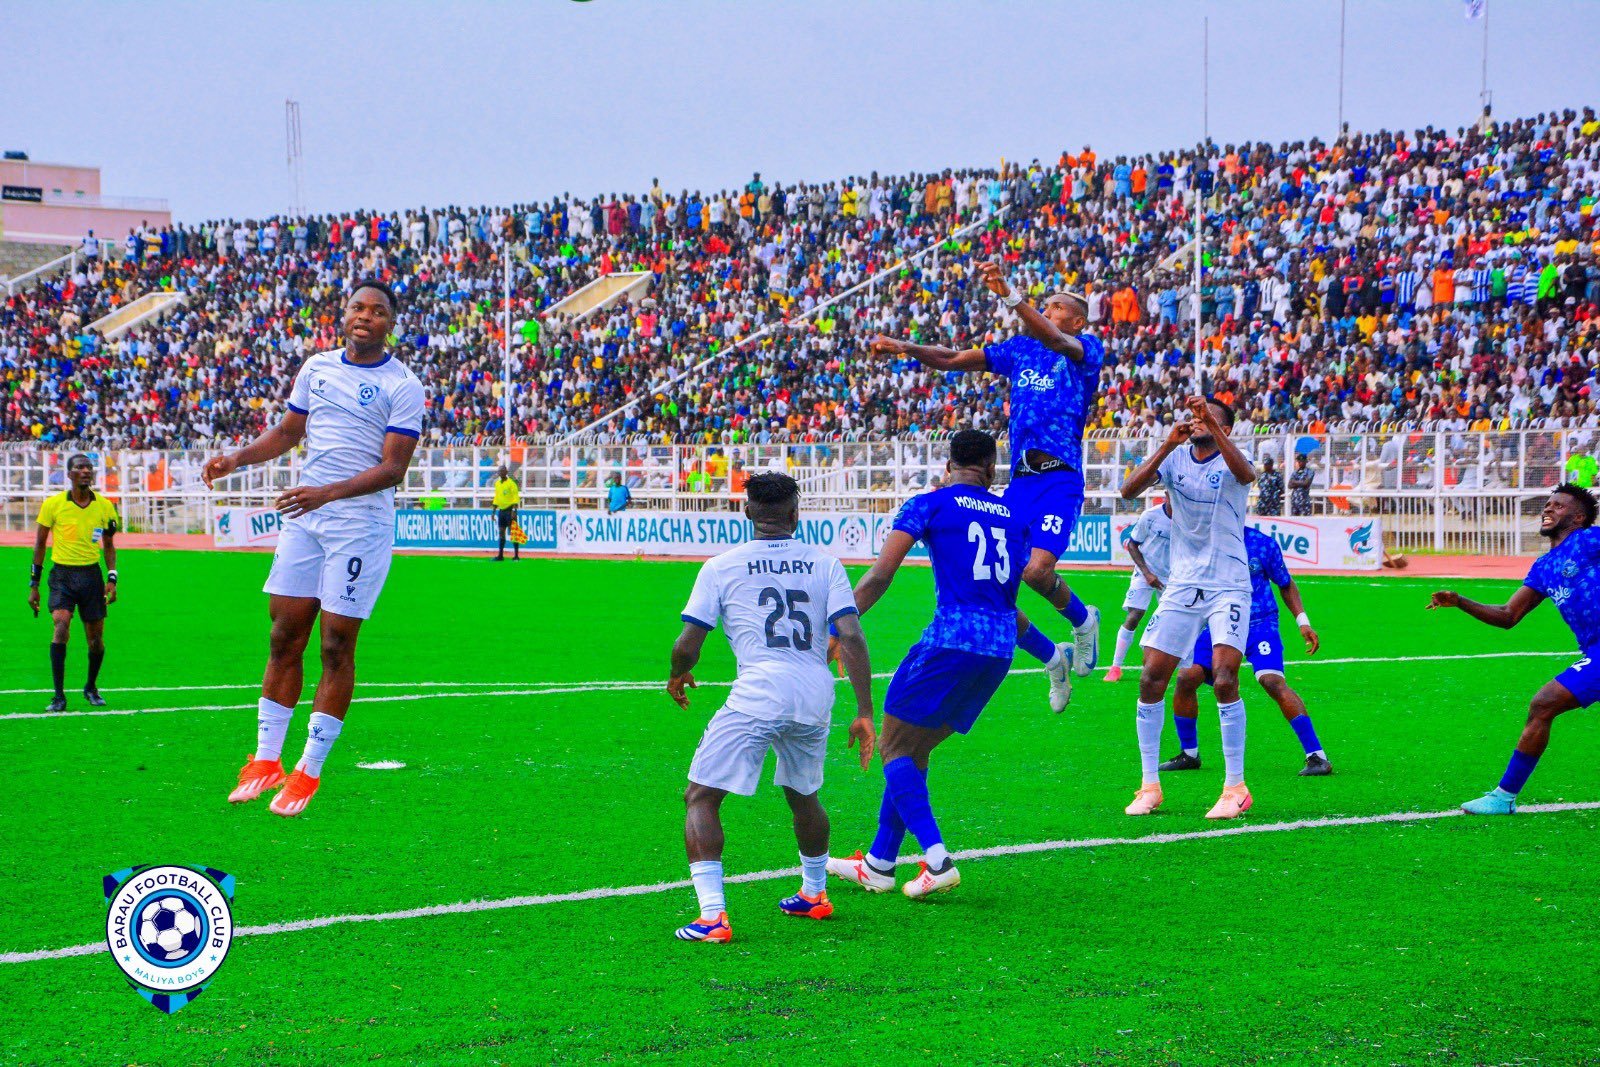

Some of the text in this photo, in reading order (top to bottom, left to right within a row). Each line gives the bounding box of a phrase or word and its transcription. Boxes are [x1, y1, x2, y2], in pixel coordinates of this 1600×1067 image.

[1018, 368, 1055, 389] Stake
[954, 496, 1011, 518] MOHAMMED
[397, 514, 430, 540] NIGERIA
[433, 514, 470, 541] PREMIER
[585, 518, 834, 546] SANI ABACHA STADI ANO
[1041, 514, 1064, 535] 33
[1065, 521, 1108, 553] EAGUE
[967, 521, 1011, 585] 23
[347, 556, 363, 582] 9
[747, 559, 814, 575] HILARY
[758, 587, 813, 651] 25
[1229, 603, 1241, 622] 5
[1257, 640, 1272, 656] 8
